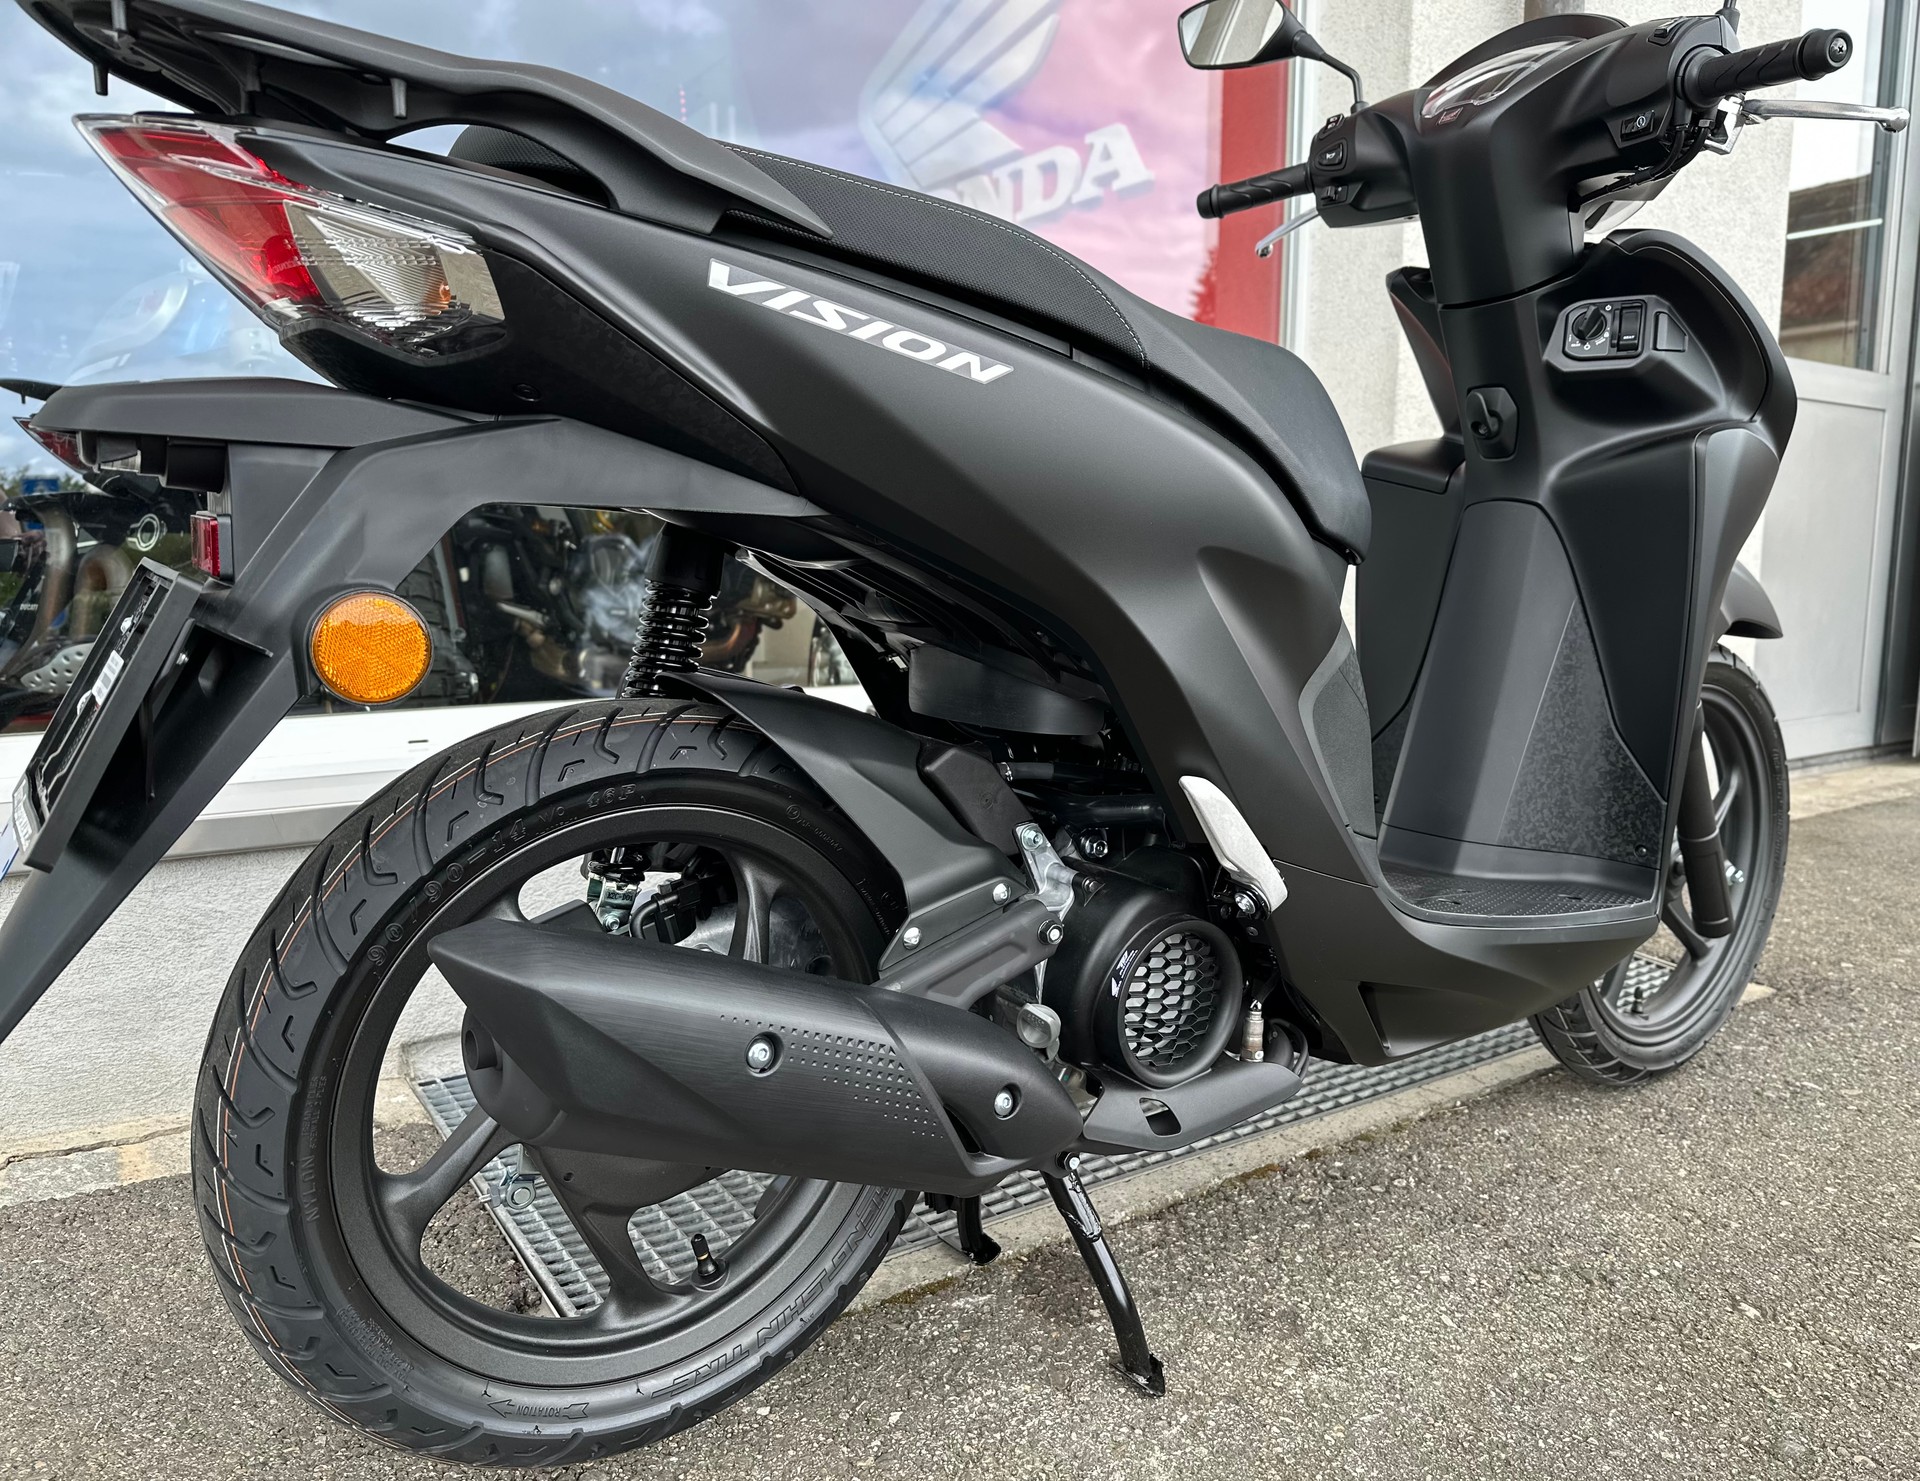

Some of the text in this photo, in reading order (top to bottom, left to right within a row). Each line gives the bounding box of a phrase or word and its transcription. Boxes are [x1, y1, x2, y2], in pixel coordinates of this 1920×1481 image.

[709, 261, 1012, 382] VISION
[586, 784, 637, 809] 46P
[301, 1154, 320, 1222] NYLON
[757, 1268, 828, 1349] SHIN
[651, 1344, 750, 1399] TIRE
[516, 1405, 561, 1417] ROTATION
